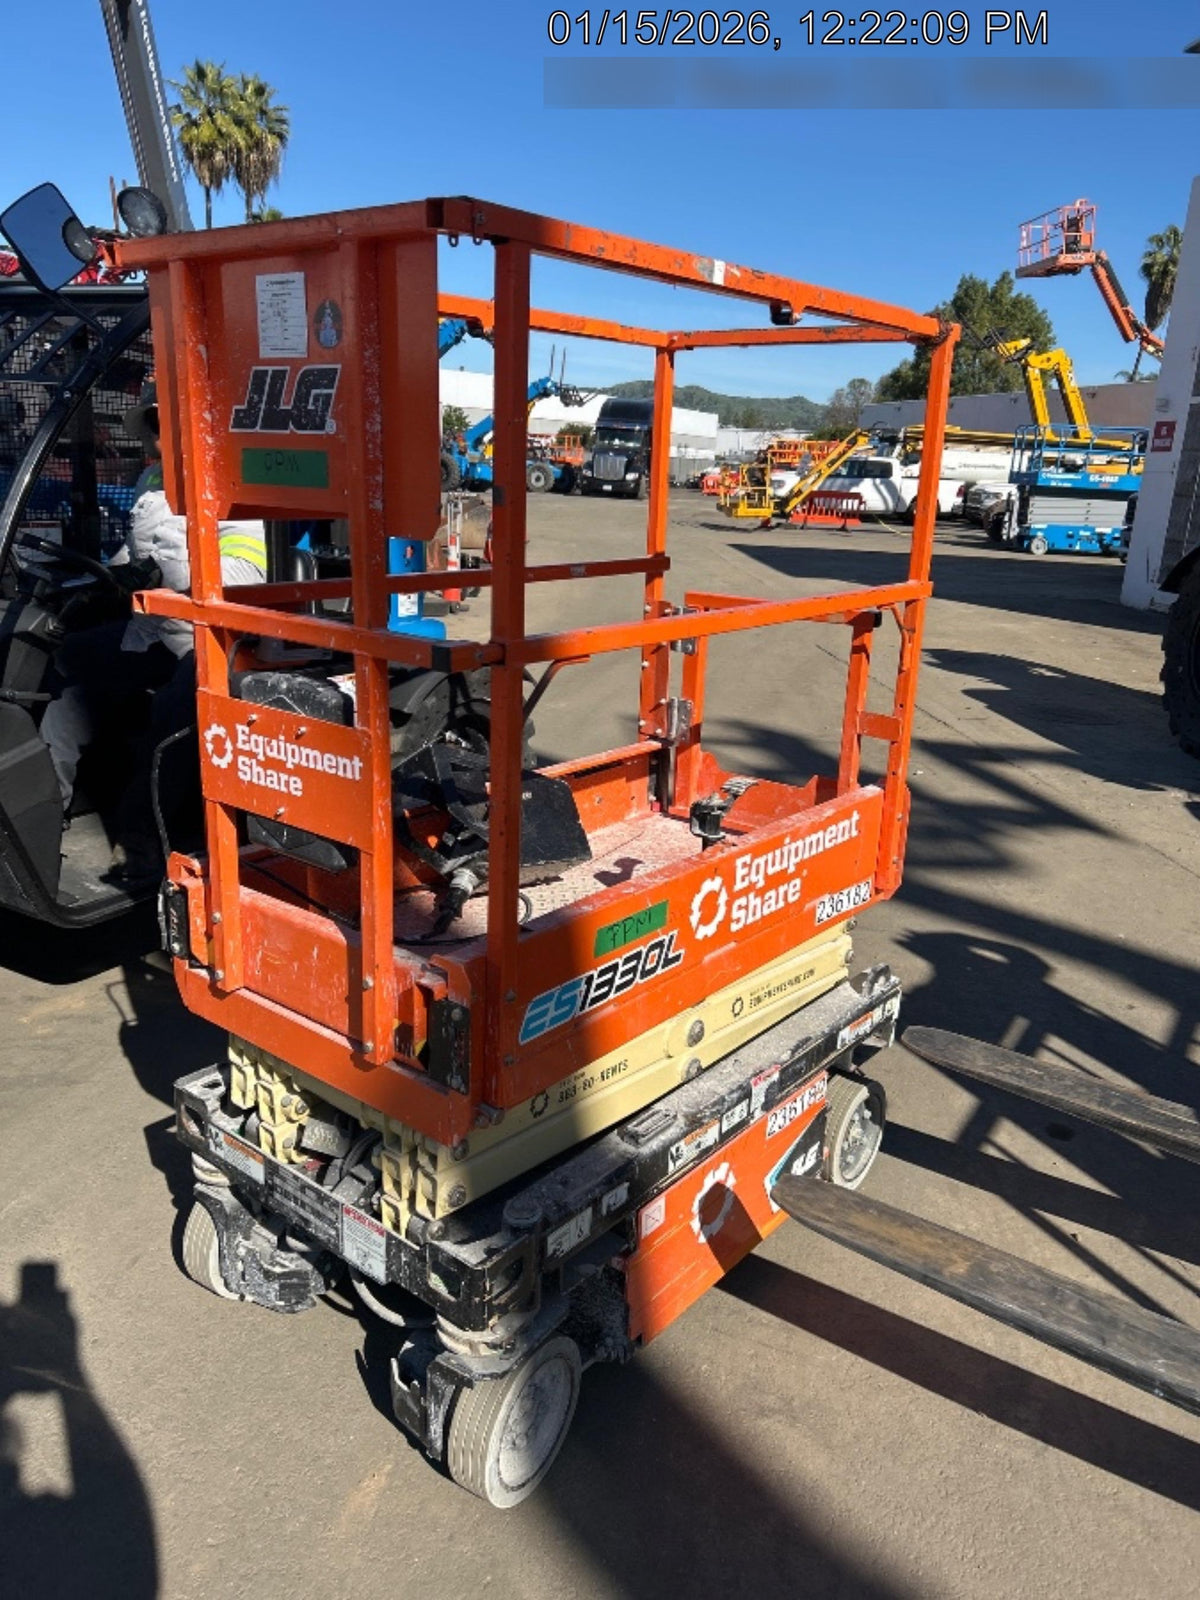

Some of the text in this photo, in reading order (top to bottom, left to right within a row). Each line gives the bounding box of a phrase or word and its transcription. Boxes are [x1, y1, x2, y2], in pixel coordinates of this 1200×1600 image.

[229, 365, 341, 433] JLG
[235, 723, 363, 781] Equipment
[237, 755, 303, 797] Share
[732, 810, 860, 892] Equipment
[730, 878, 802, 933] Share
[816, 880, 871, 923] 236182
[518, 929, 685, 1045] ES1330L
